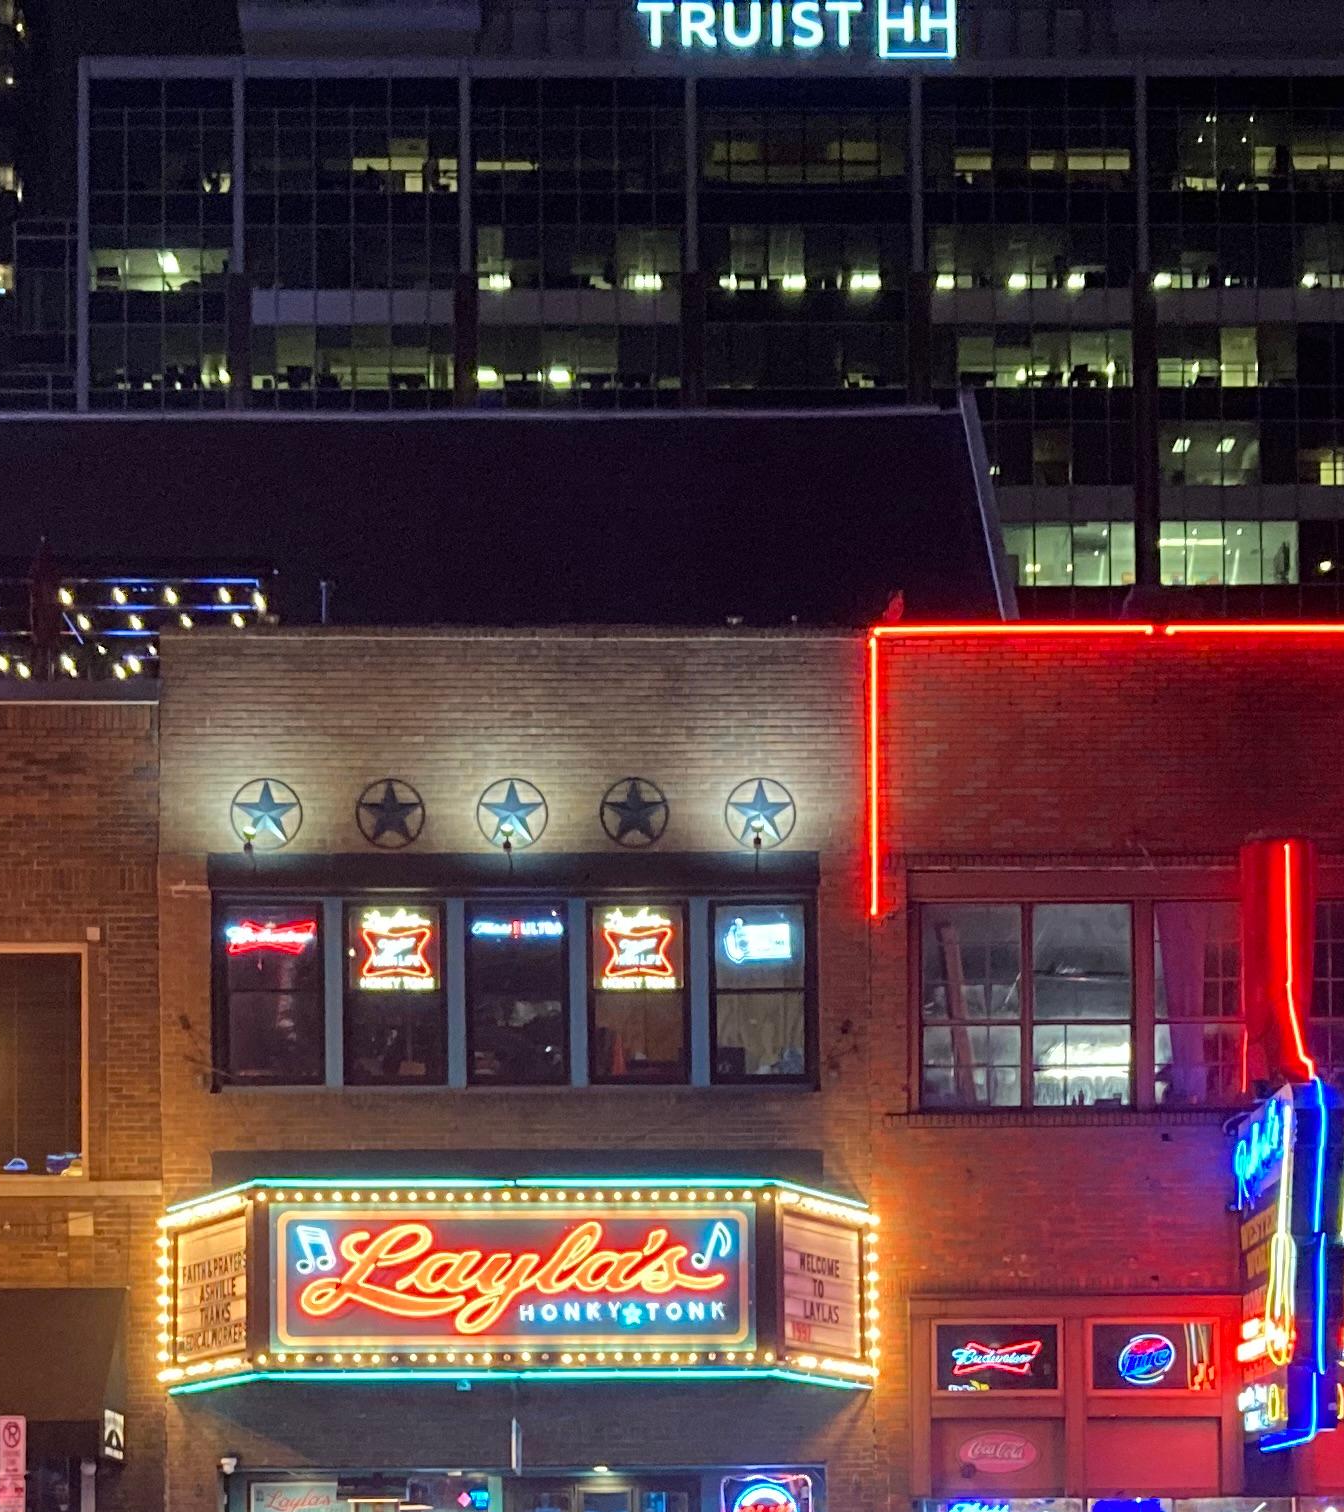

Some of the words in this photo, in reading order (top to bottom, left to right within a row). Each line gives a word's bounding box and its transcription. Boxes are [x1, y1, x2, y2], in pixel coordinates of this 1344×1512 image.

[637, 0, 864, 48] TRUIST
[301, 1220, 725, 1334] Layla's
[799, 1252, 840, 1278] WELCOME
[812, 1278, 825, 1298] TO
[519, 1302, 622, 1321] HONKY
[644, 1301, 726, 1321] TONK
[803, 1301, 840, 1324] LAYLAS
